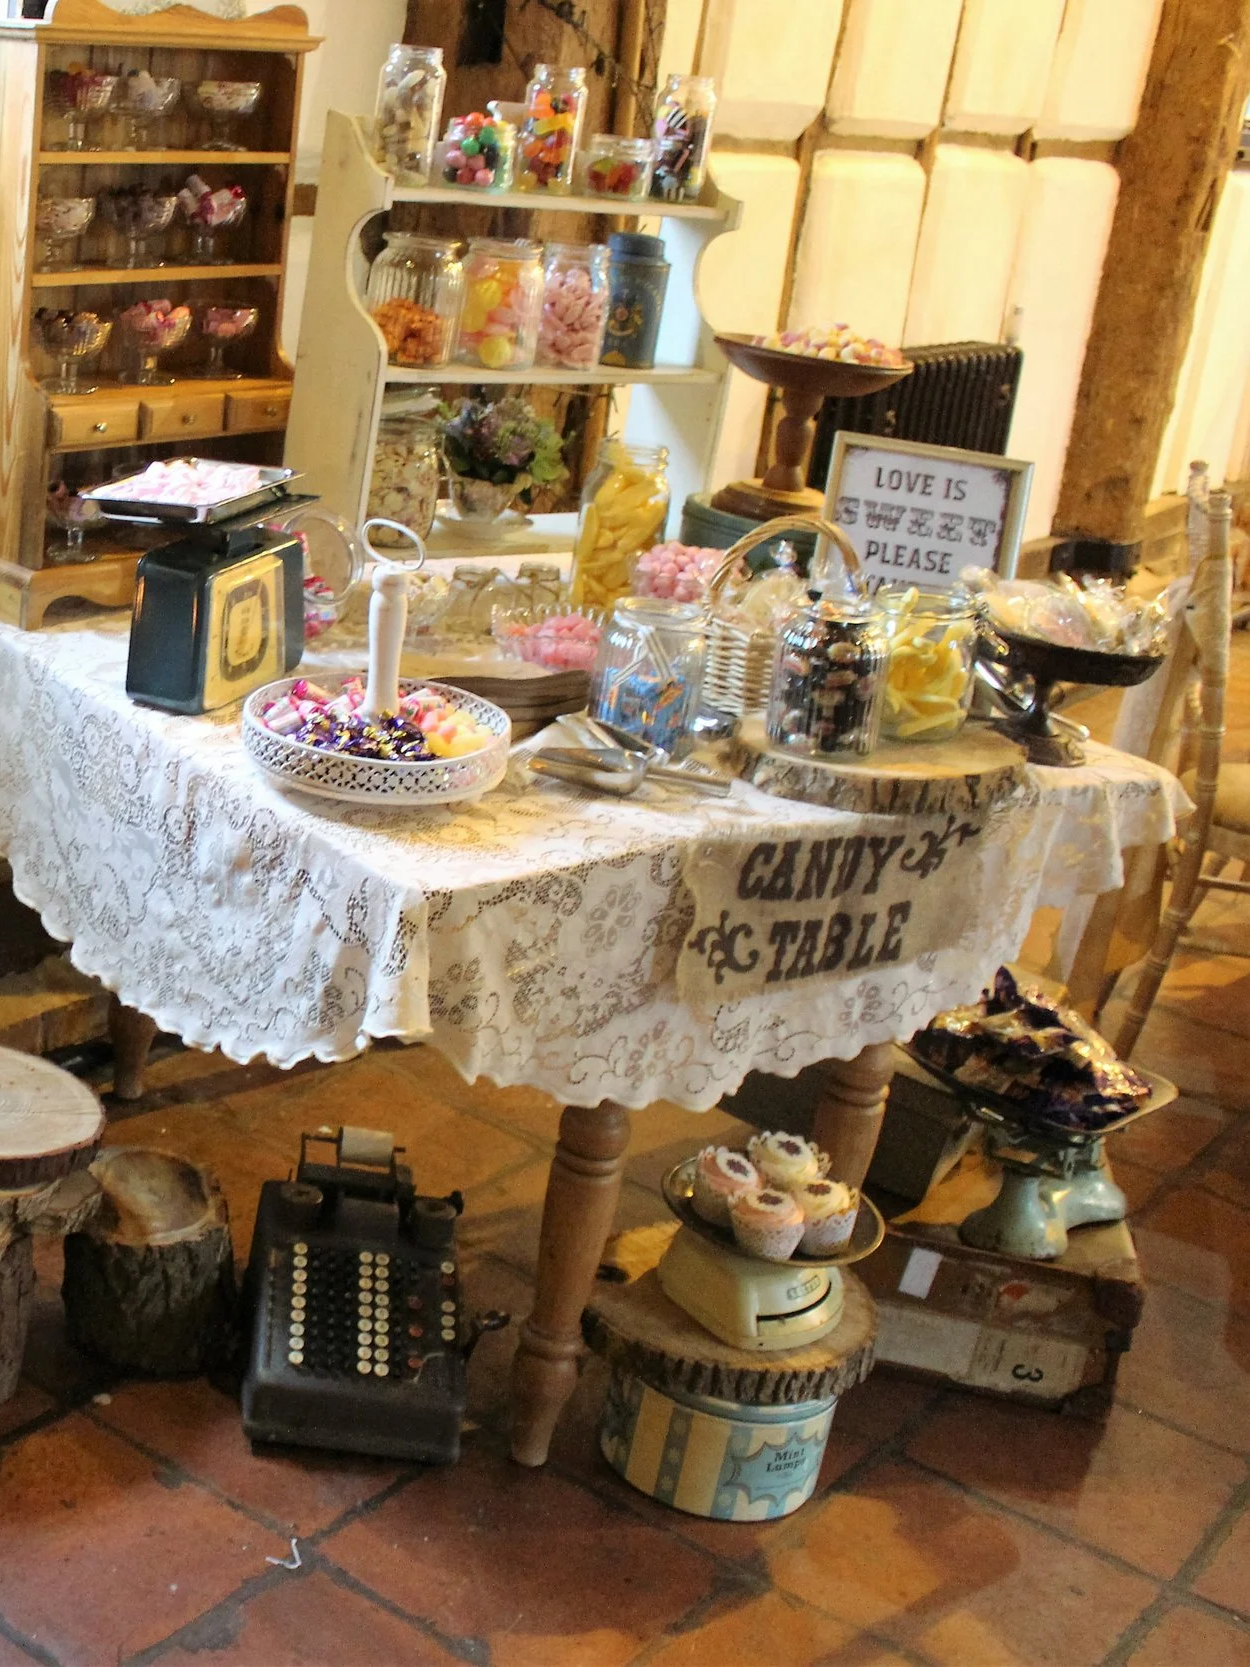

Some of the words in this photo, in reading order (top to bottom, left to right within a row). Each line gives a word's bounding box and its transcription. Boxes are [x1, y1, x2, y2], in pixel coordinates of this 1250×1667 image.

[874, 466, 936, 497] LOVE
[942, 477, 969, 502] IS
[835, 495, 997, 548] SWEET
[864, 540, 953, 575] PLEASE
[737, 835, 905, 902] CANDY
[765, 900, 912, 984] TABLE
[774, 1447, 805, 1462] Mint
